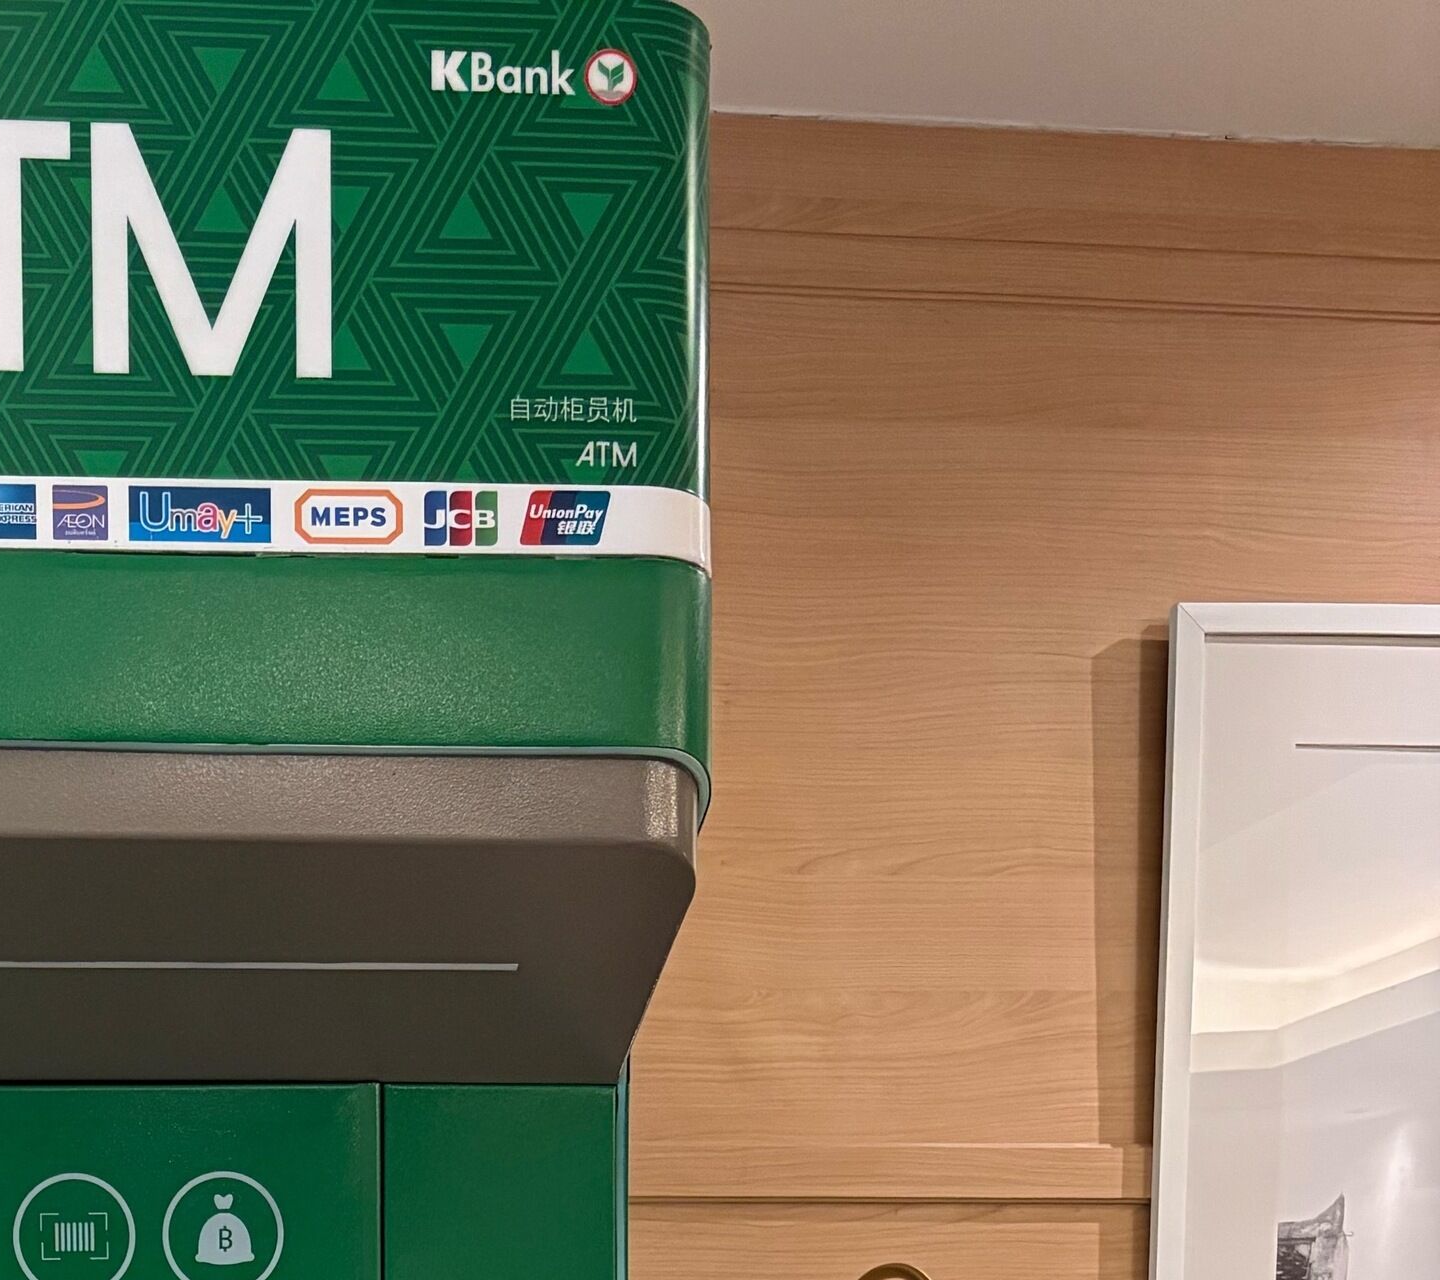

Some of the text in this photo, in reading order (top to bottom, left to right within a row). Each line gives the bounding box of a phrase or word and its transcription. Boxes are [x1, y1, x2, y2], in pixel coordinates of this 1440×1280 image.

[431, 50, 576, 96] KBank
[511, 394, 637, 422] 自动柜员机
[576, 440, 637, 467] ATM
[139, 491, 263, 539] Umay+
[311, 506, 387, 527] MEPS
[423, 508, 496, 530] JCB
[529, 502, 604, 526] UnionPay
[557, 519, 596, 537] 银联
